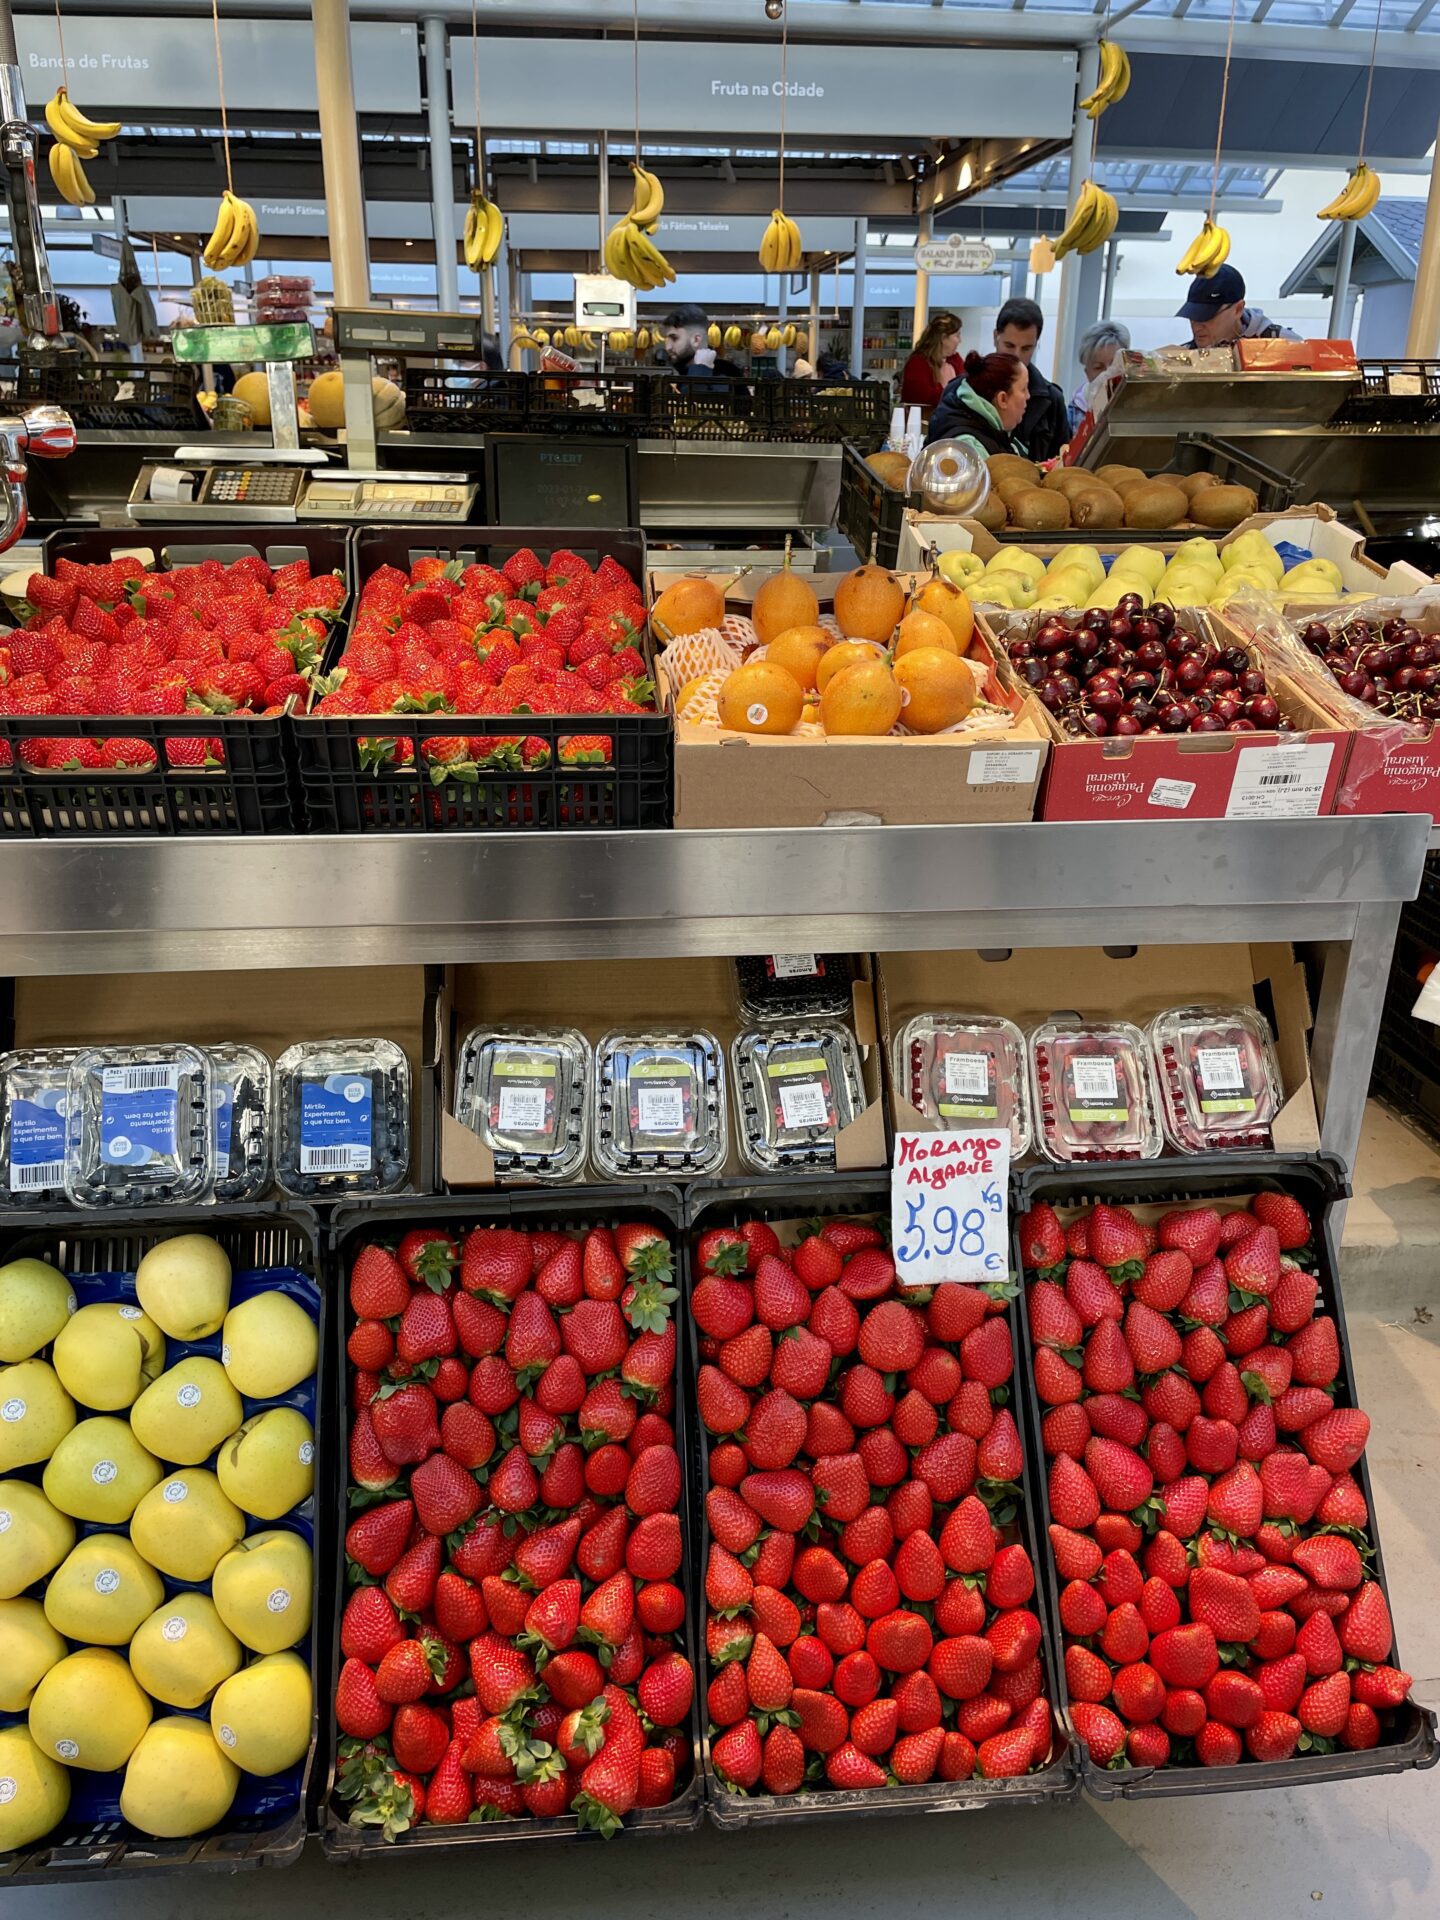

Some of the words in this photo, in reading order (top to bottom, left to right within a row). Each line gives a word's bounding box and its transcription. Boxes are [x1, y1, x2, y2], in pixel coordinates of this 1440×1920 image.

[29, 52, 75, 69] Banca
[79, 53, 98, 69] de
[102, 54, 149, 70] Frutas
[711, 80, 749, 96] Fruta
[752, 84, 769, 96] na
[772, 81, 825, 98] Cidade
[261, 204, 295, 215] Frutaria
[1382, 755, 1430, 767] Austral
[1383, 764, 1440, 778] Patagonia
[1086, 772, 1131, 785] Austral
[1085, 780, 1145, 795] Patagonia
[949, 1056, 985, 1064] Framboesa
[154, 1109, 169, 1117] que
[304, 1110, 346, 1118] Experimenta
[13, 1119, 36, 1127] Mirtilo
[798, 1116, 824, 1124] Amoras
[151, 1126, 175, 1134] Mirtilo
[20, 1136, 33, 1144] que
[896, 1192, 986, 1263] 5.98
[984, 1252, 1001, 1271] €
